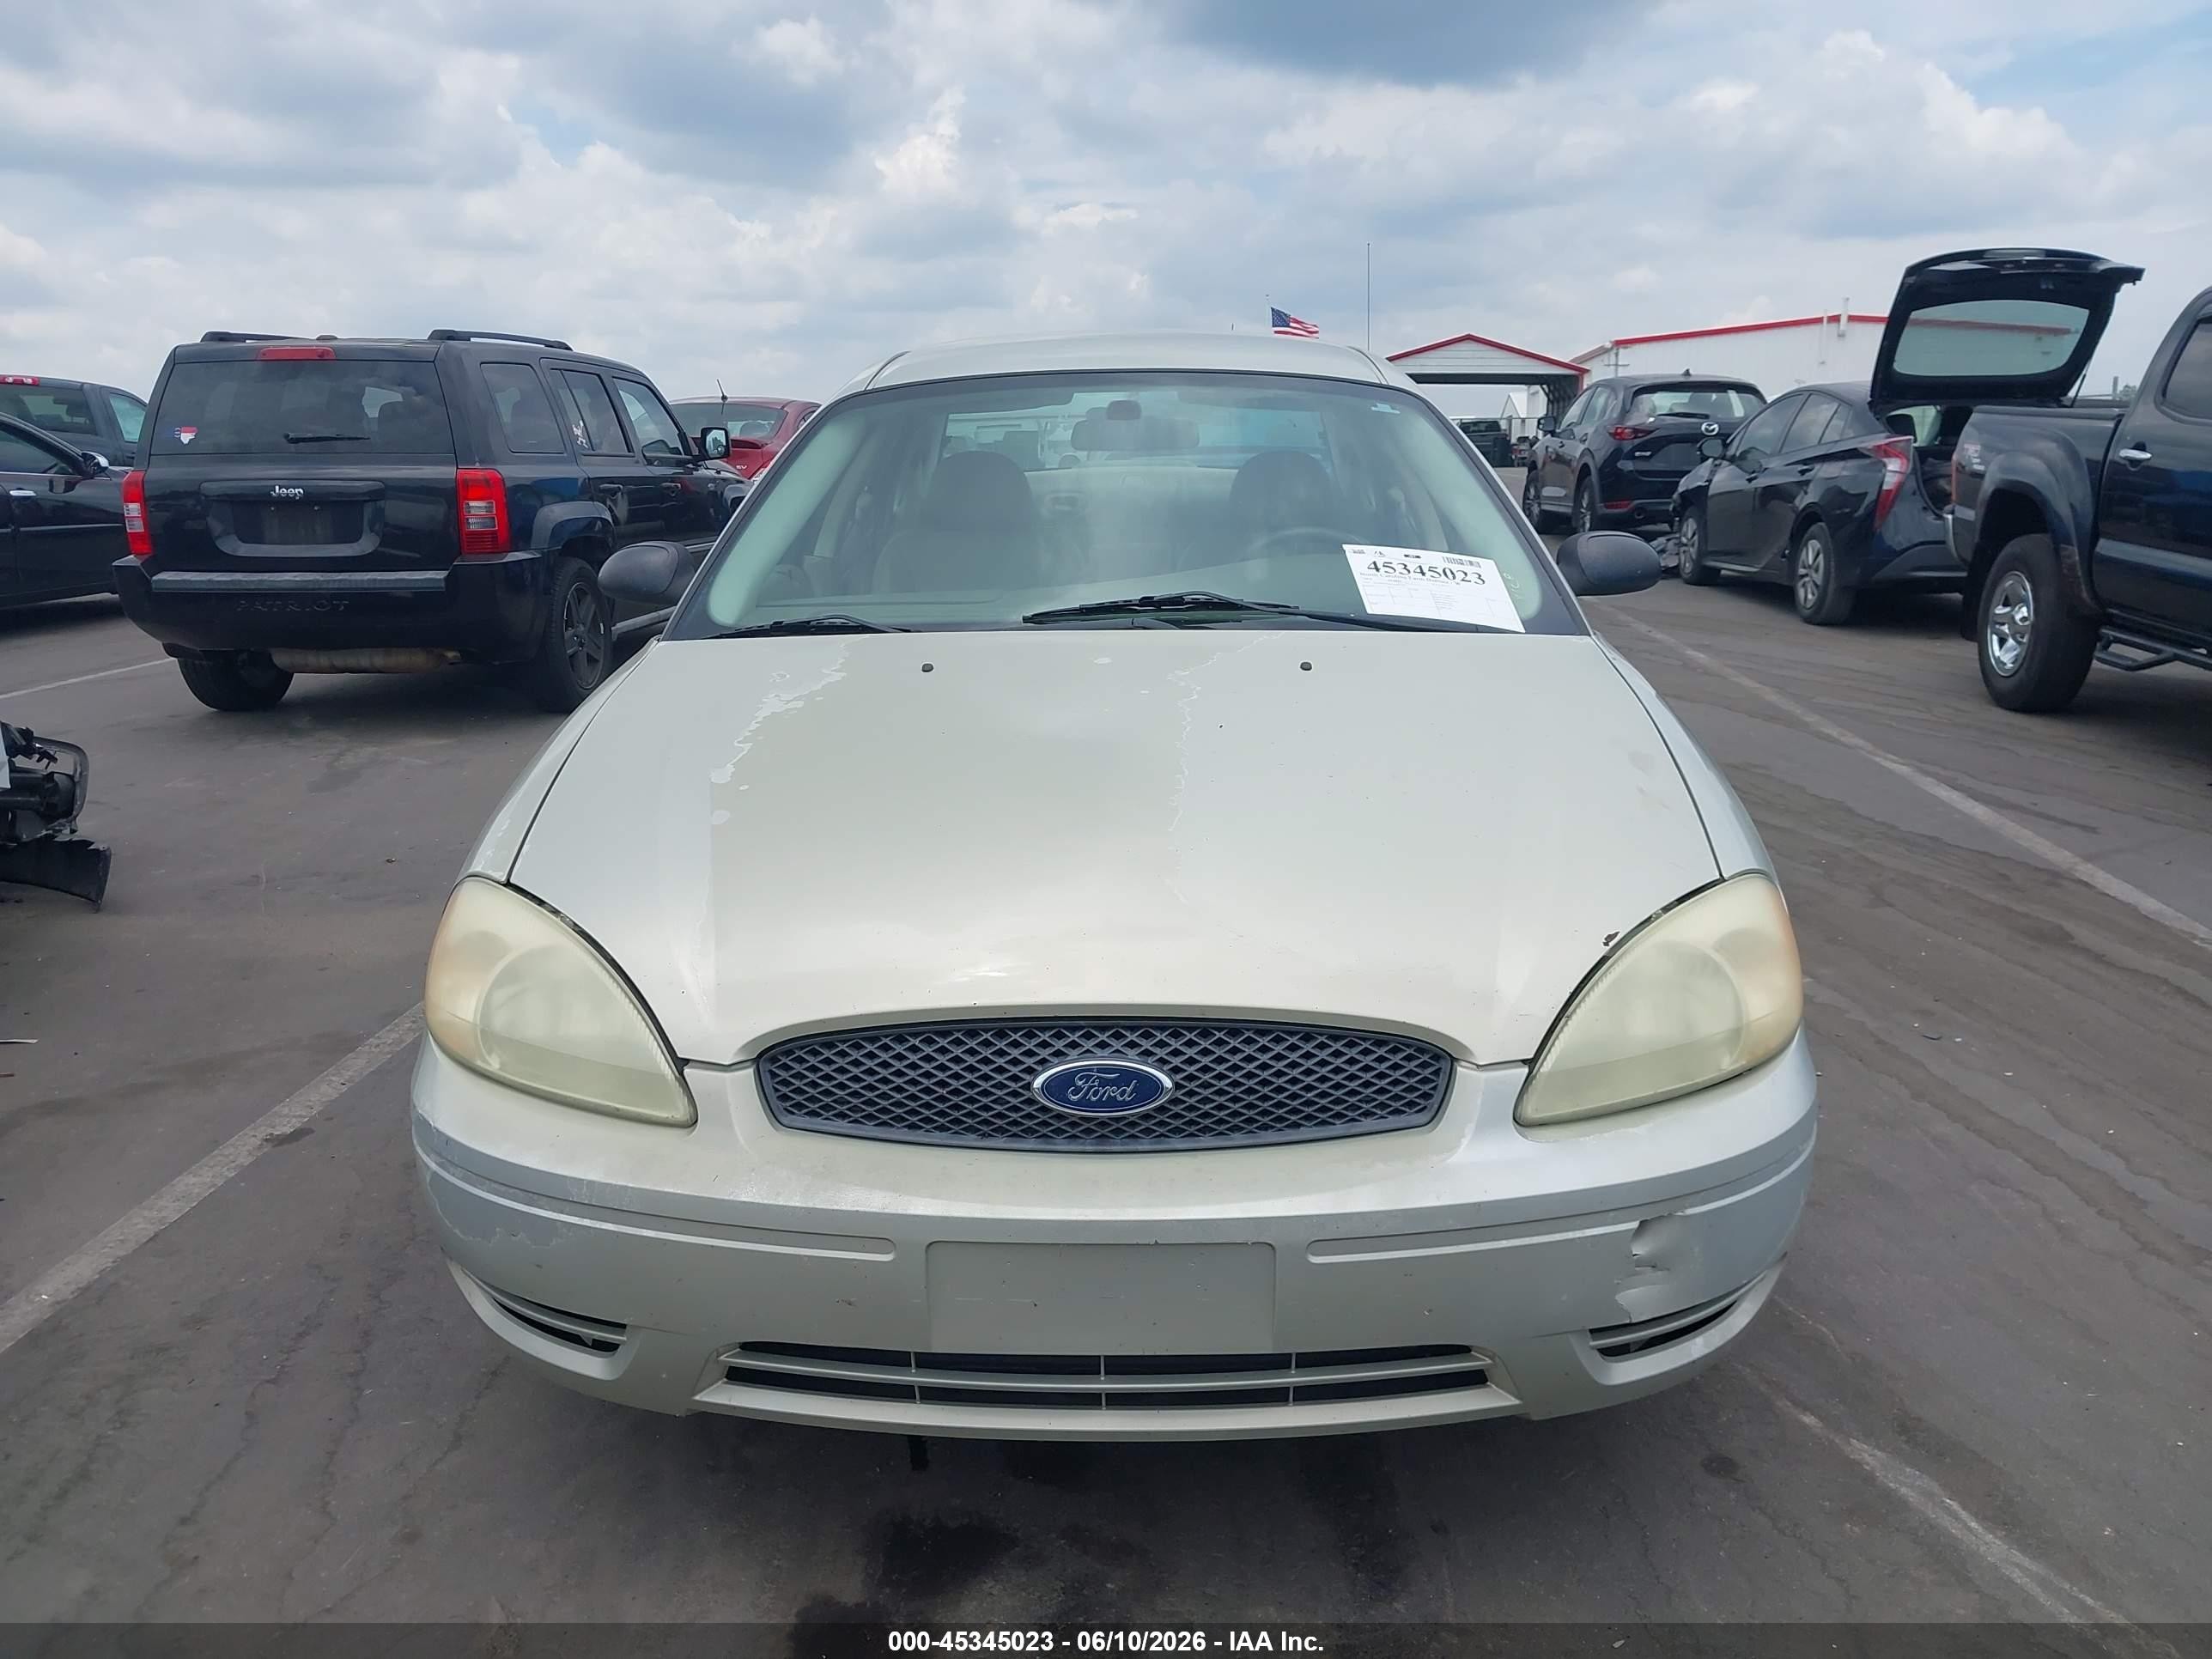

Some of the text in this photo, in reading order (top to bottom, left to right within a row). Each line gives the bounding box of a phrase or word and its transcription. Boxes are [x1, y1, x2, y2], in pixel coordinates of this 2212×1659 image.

[270, 484, 304, 500] Jeep
[1366, 560, 1486, 586] 45345023
[236, 600, 349, 611] PATRIOT
[1067, 1071, 1138, 1102] Ford
